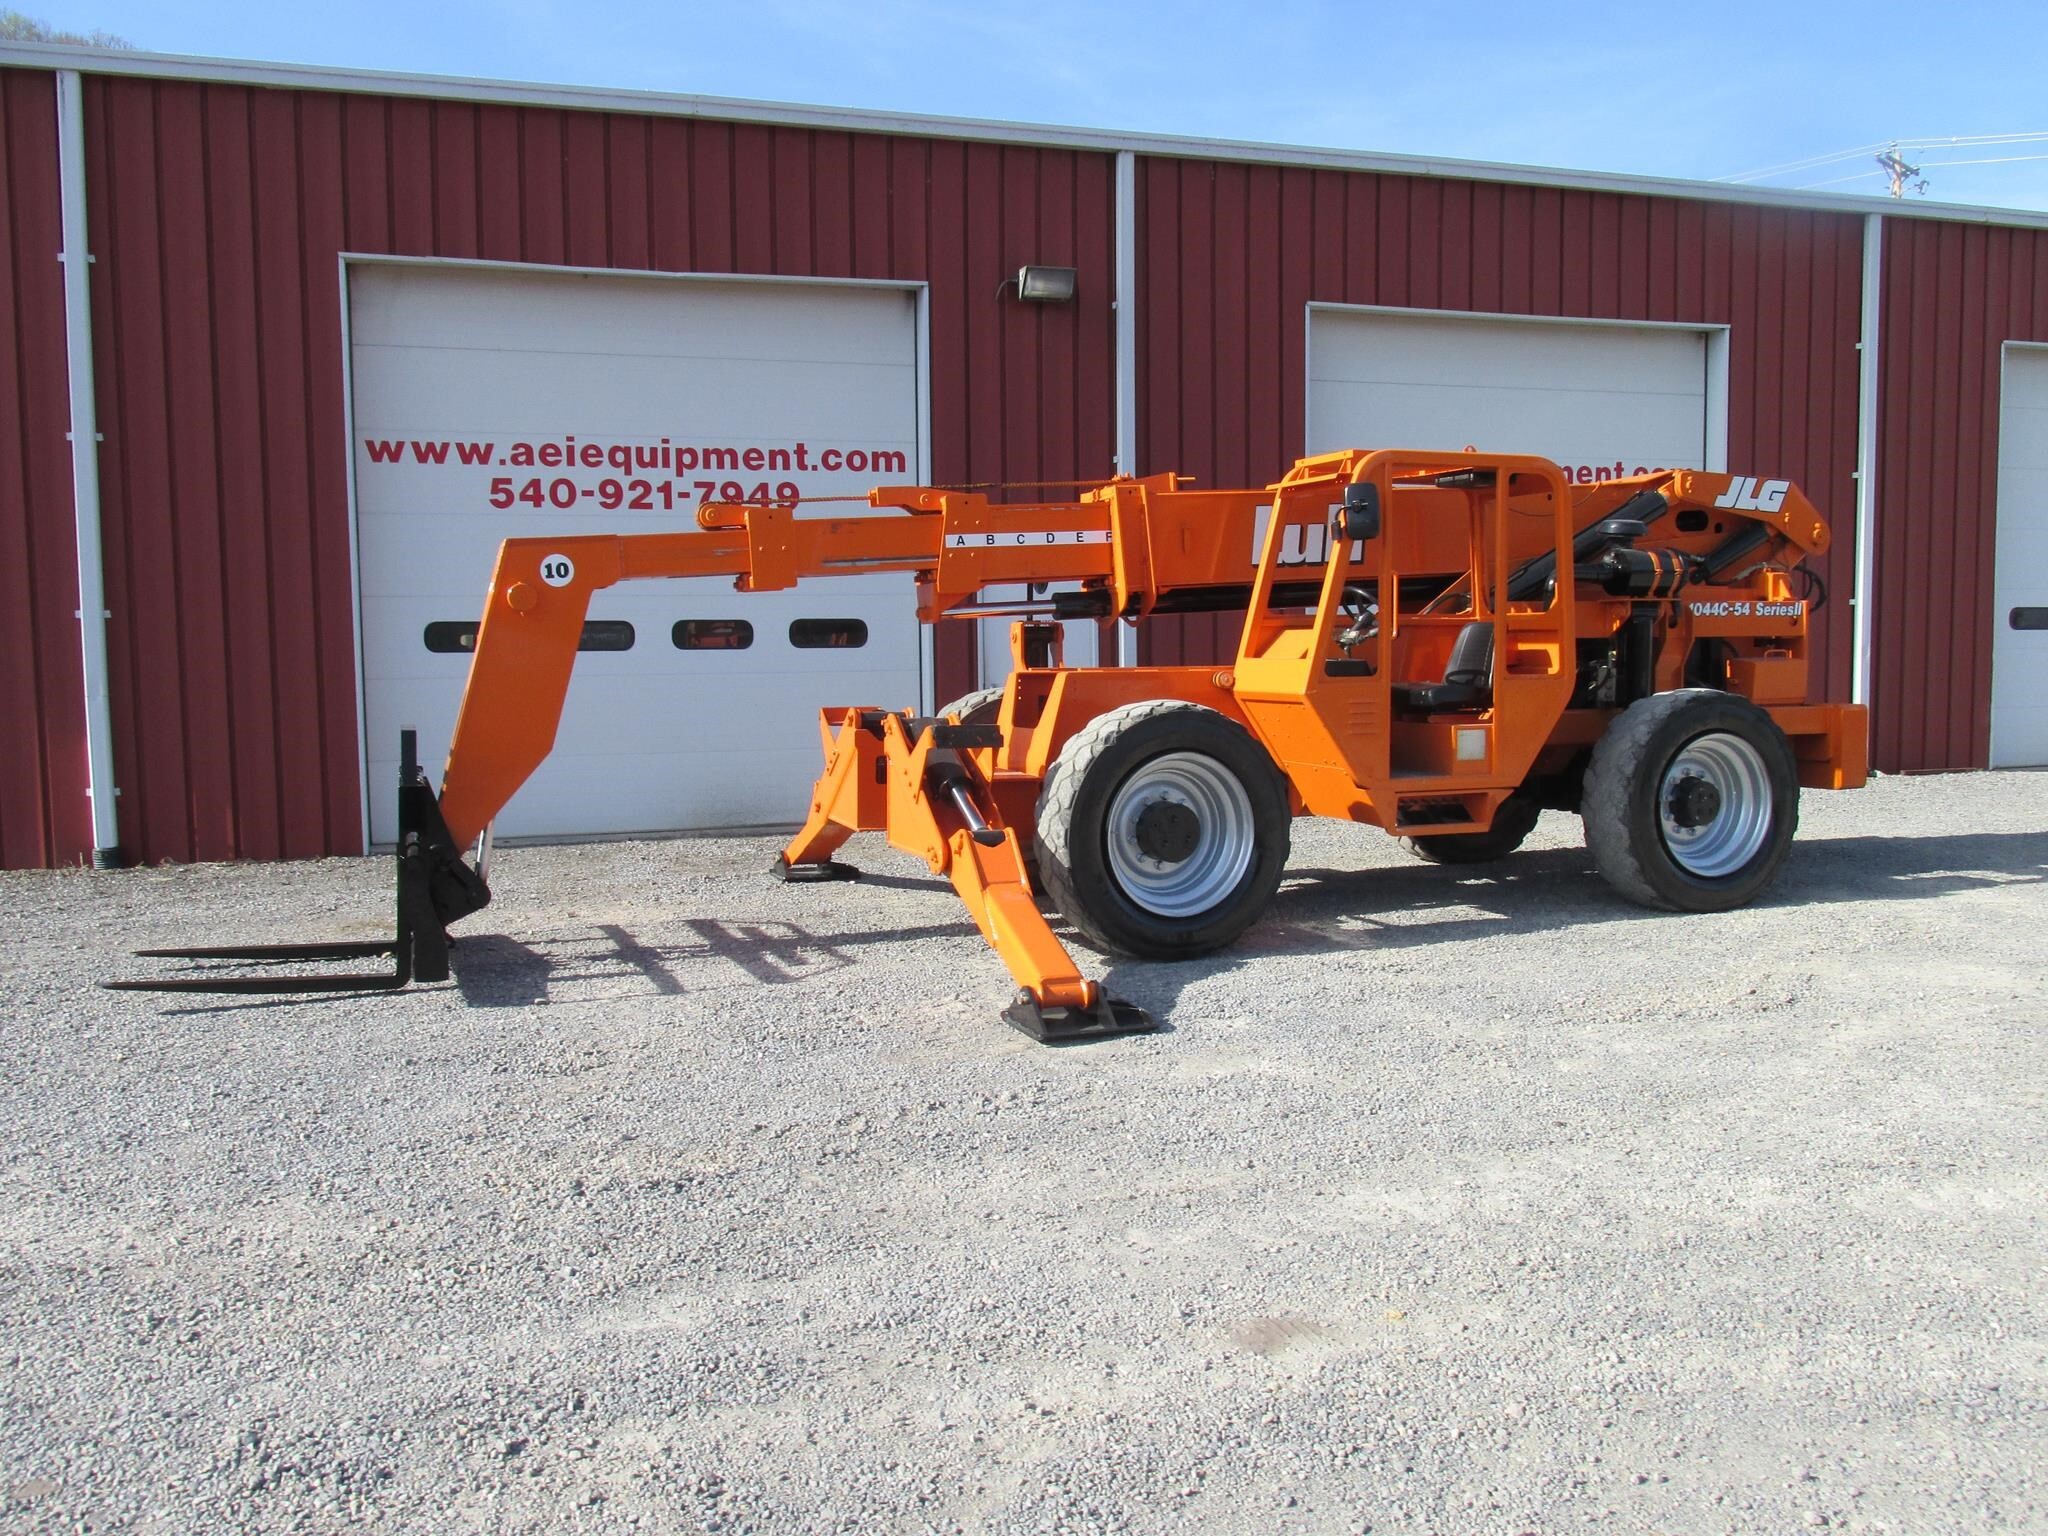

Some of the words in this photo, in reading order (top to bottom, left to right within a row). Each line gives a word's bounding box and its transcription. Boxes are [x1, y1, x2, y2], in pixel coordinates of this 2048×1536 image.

[365, 436, 907, 477] www.aeiequipment.com
[488, 477, 800, 510] 540-921-7949
[1714, 475, 1791, 513] JLG
[956, 535, 966, 546] A
[986, 534, 995, 545] B
[1016, 533, 1026, 545] C
[1046, 532, 1055, 543] D
[1076, 532, 1084, 542] E
[544, 562, 569, 579] 10
